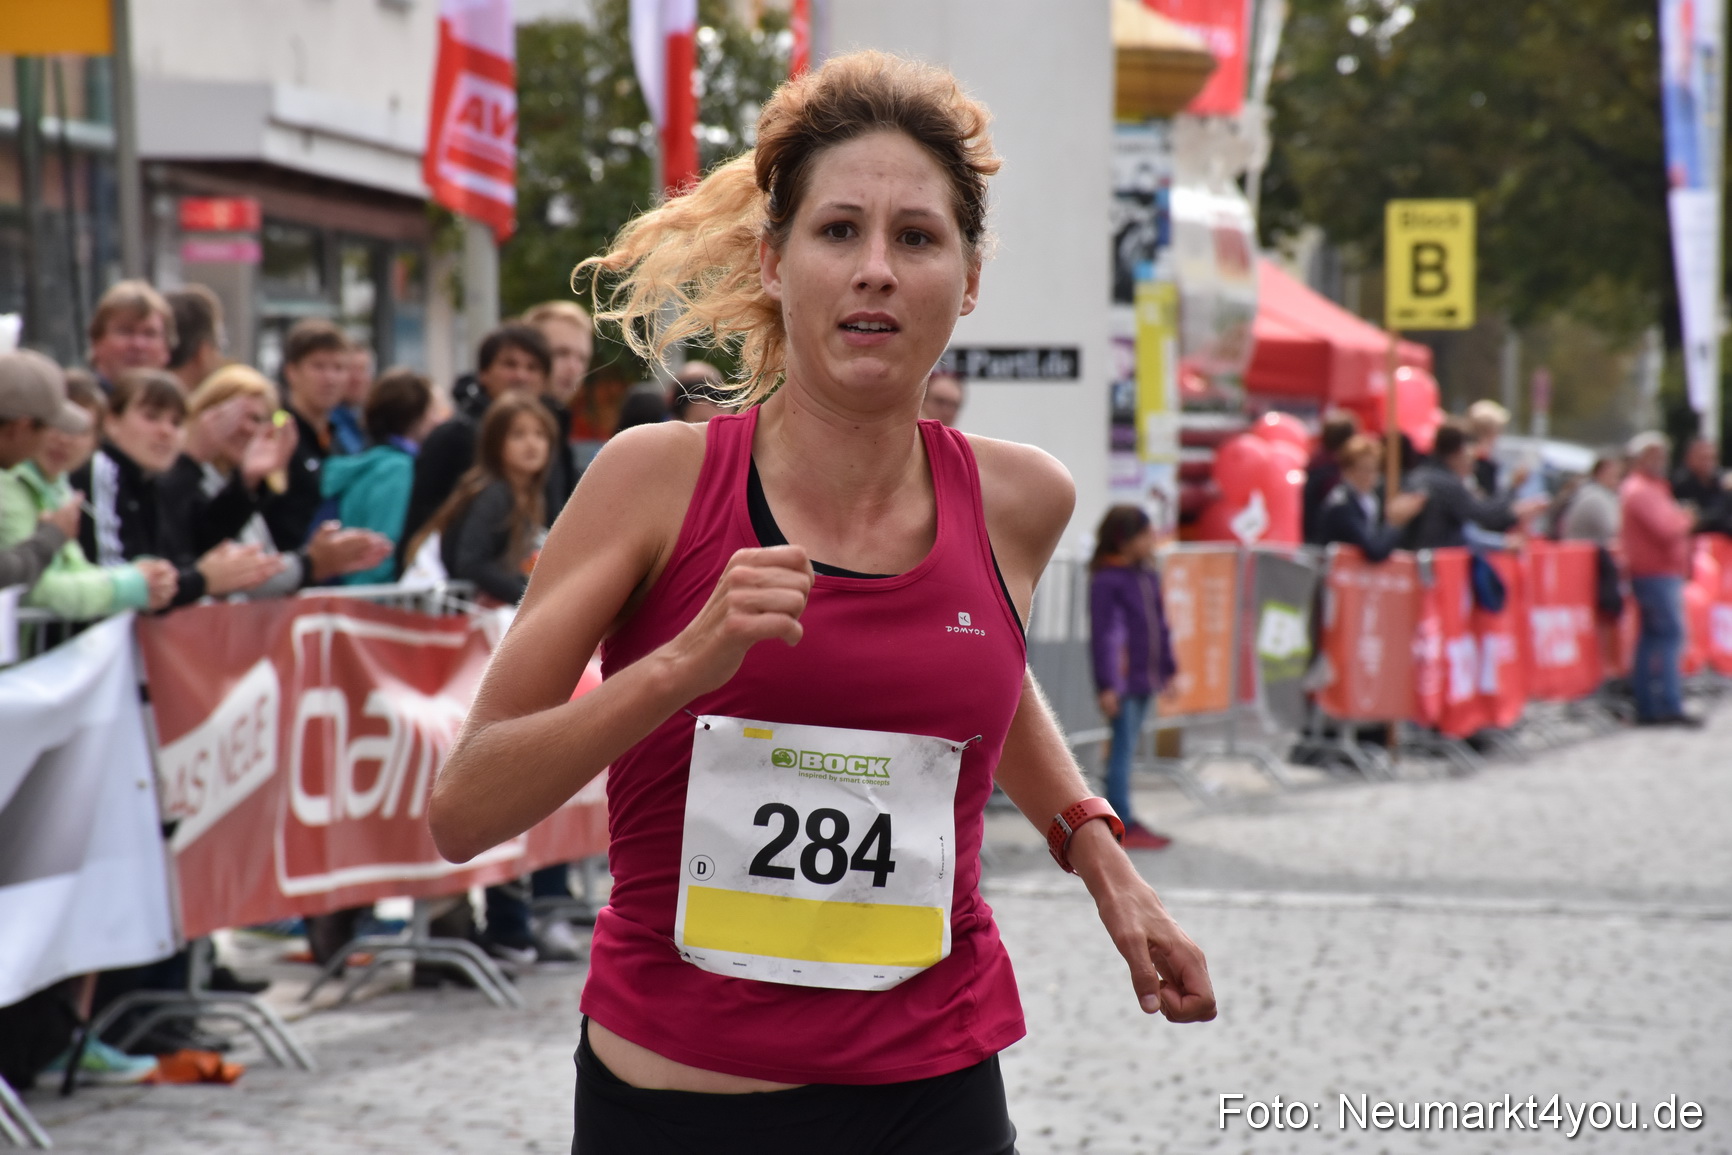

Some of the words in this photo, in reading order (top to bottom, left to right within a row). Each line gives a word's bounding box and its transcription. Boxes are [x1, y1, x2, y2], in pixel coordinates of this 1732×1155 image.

[1410, 241, 1450, 298] B
[945, 625, 986, 636] DOMYOS
[799, 750, 891, 778] BOCK
[798, 771, 827, 780] inspired
[829, 774, 838, 782] by
[749, 802, 895, 888] 284
[697, 861, 706, 875] D
